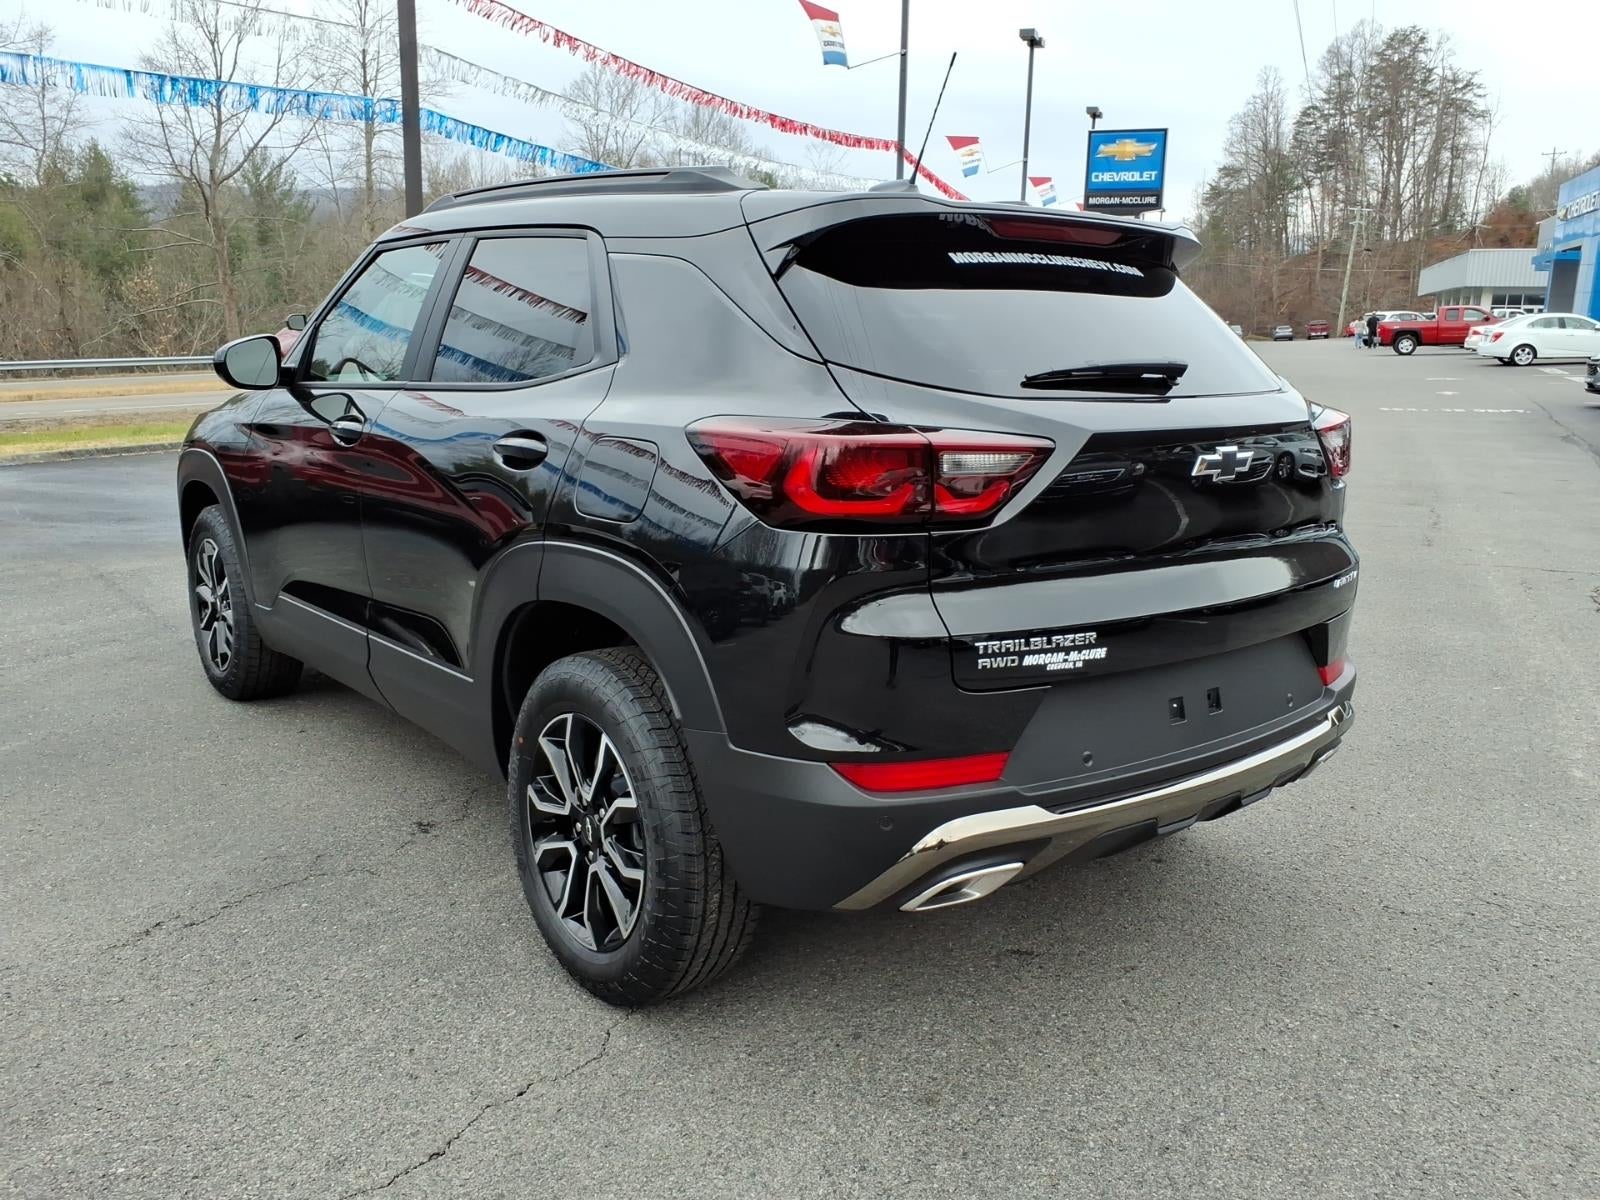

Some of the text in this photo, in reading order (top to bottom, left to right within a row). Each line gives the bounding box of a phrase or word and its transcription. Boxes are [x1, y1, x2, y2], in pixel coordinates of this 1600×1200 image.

[1091, 170, 1158, 182] CHEVROLET
[1088, 196, 1157, 205] MORGAN-MCCLURE
[948, 251, 1144, 277] MORGANMCCLURECHEVY.COM
[974, 632, 1097, 654] TRAILBLAZER
[977, 655, 1019, 670] AWD
